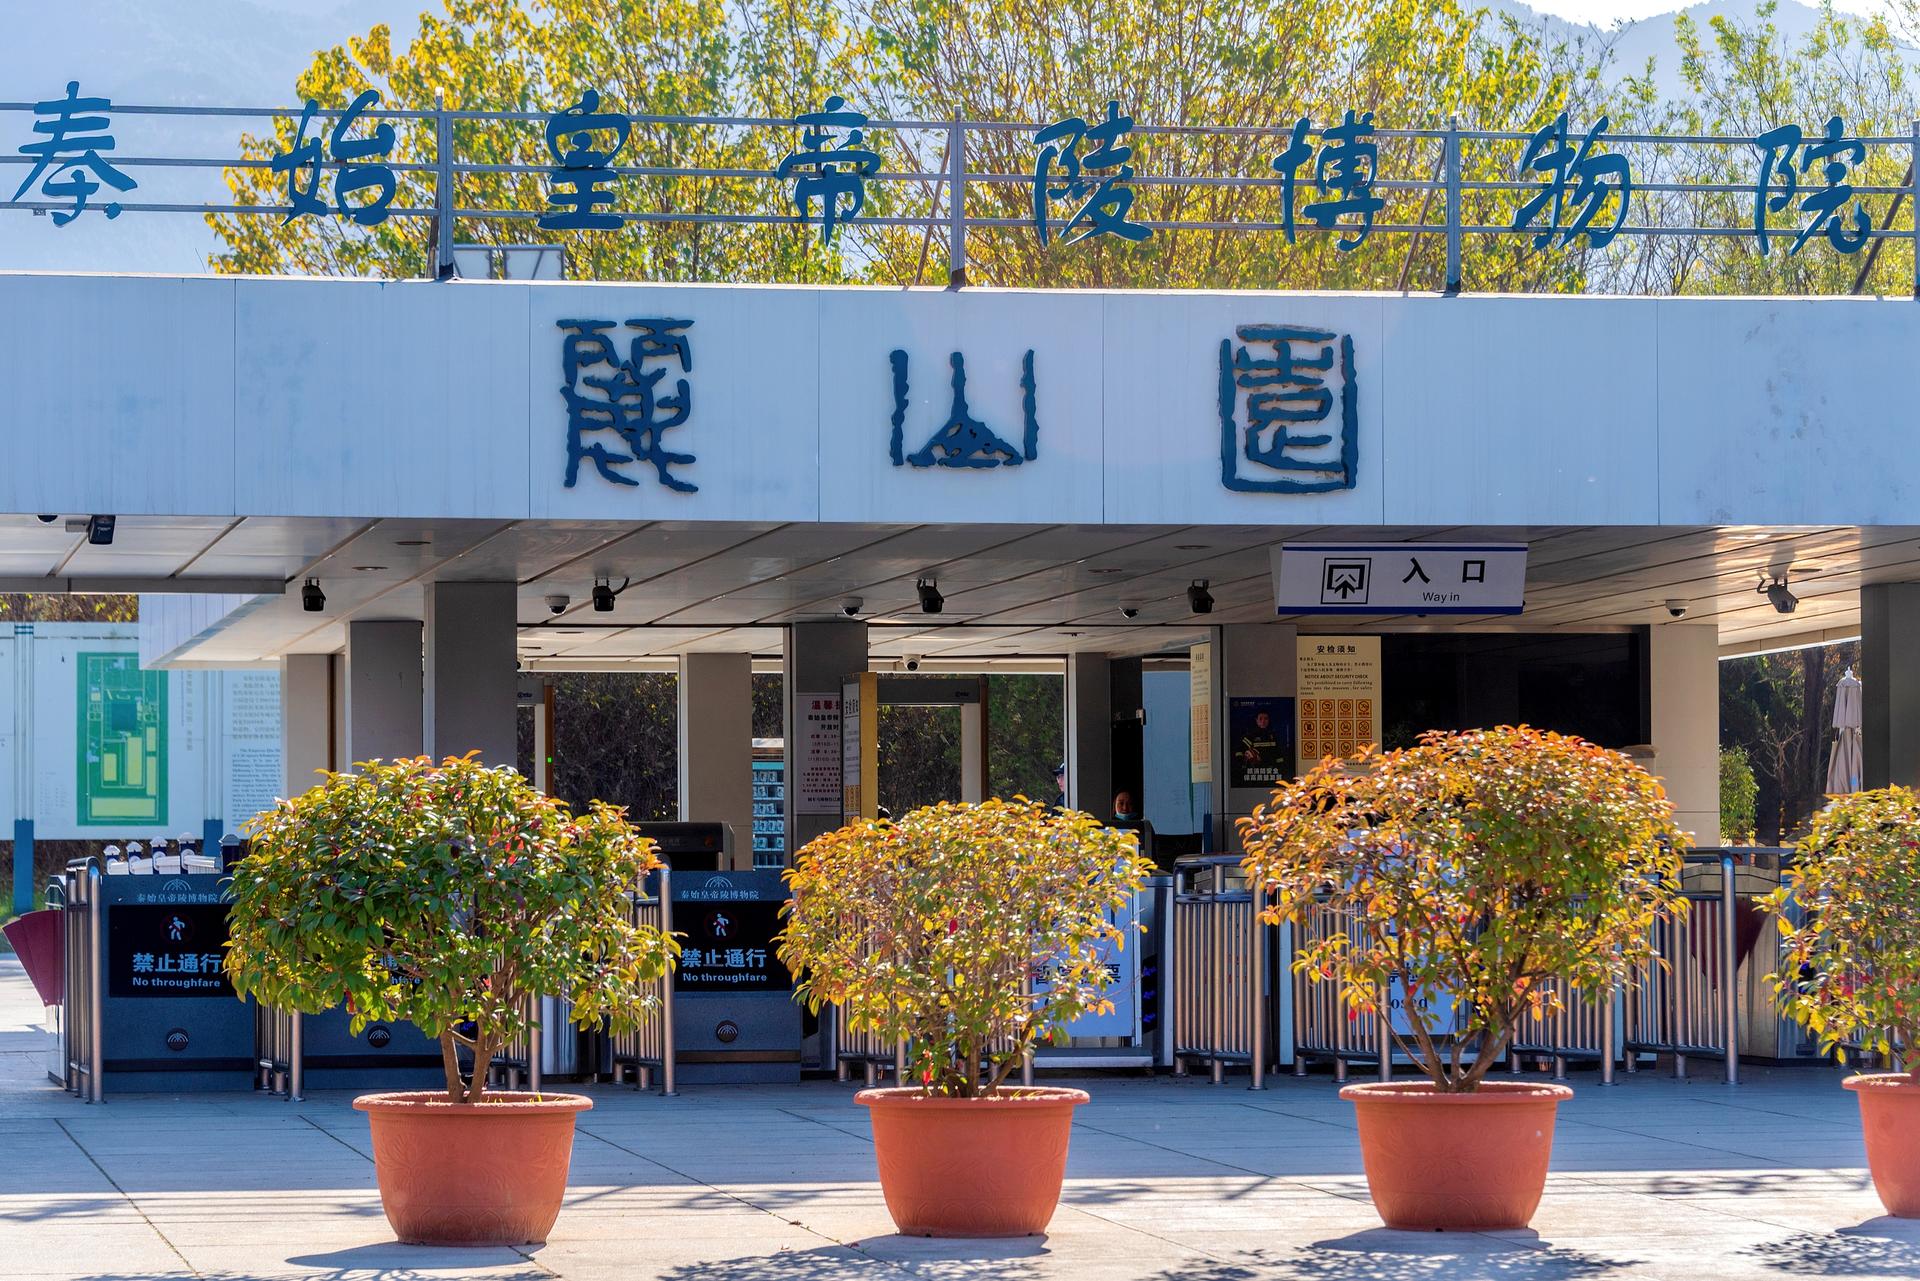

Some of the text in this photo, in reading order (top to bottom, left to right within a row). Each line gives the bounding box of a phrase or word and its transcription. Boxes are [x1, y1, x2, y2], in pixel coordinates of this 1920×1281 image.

[11, 81, 1872, 256] 秦始皇帝陵博物院
[1402, 557, 1486, 584] 入口
[1422, 591, 1460, 603] Way in
[1316, 645, 1356, 654] 安检须知
[682, 890, 760, 899] 秦始皇帝陵博物院
[133, 952, 222, 973] 禁止通行
[682, 948, 767, 968] 禁止通行
[132, 977, 221, 989] No throughfare
[683, 972, 767, 983] No throughfare
